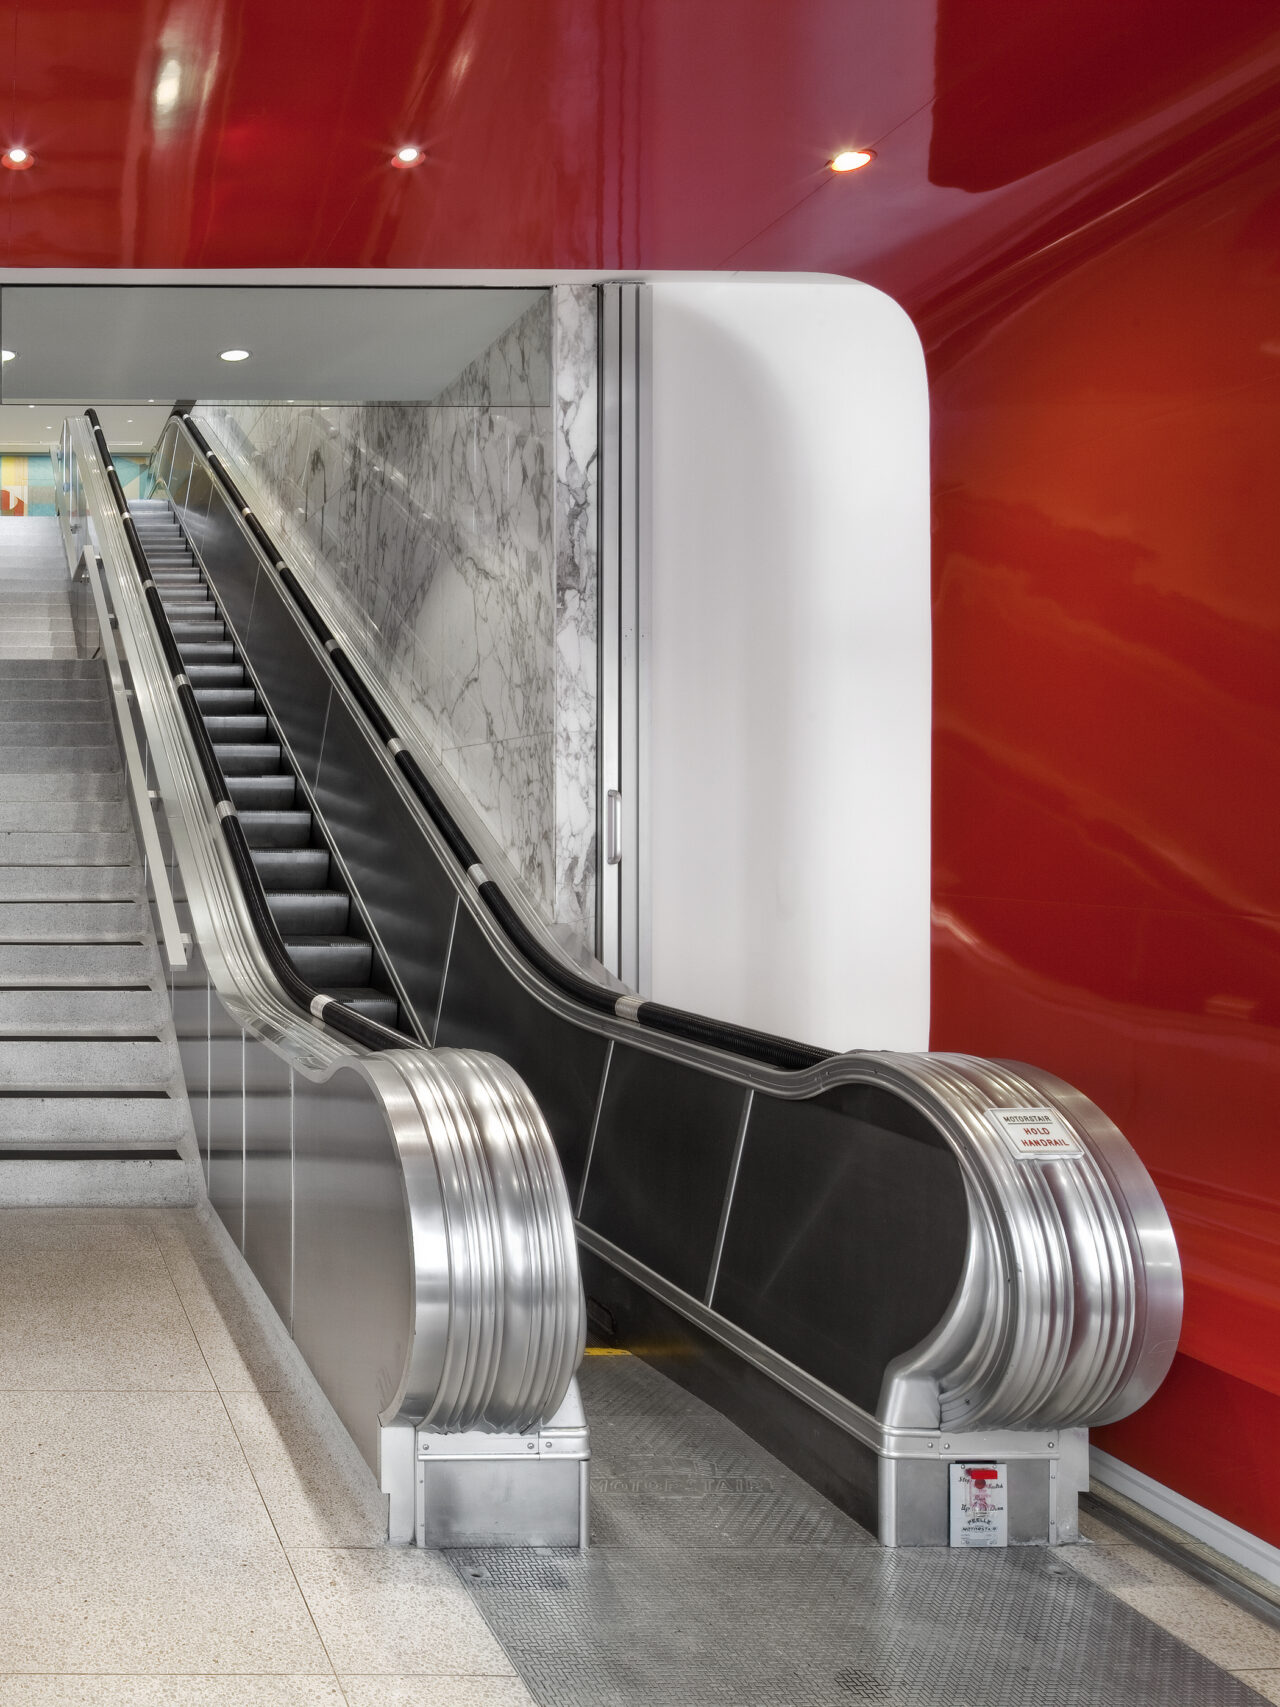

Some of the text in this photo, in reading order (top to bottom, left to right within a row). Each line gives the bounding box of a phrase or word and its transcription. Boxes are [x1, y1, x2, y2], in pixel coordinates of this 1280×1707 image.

[1003, 1115, 1052, 1123] MOTORSTAIR
[1023, 1127, 1051, 1135] HOLD
[1021, 1139, 1070, 1147] HANDRAIL
